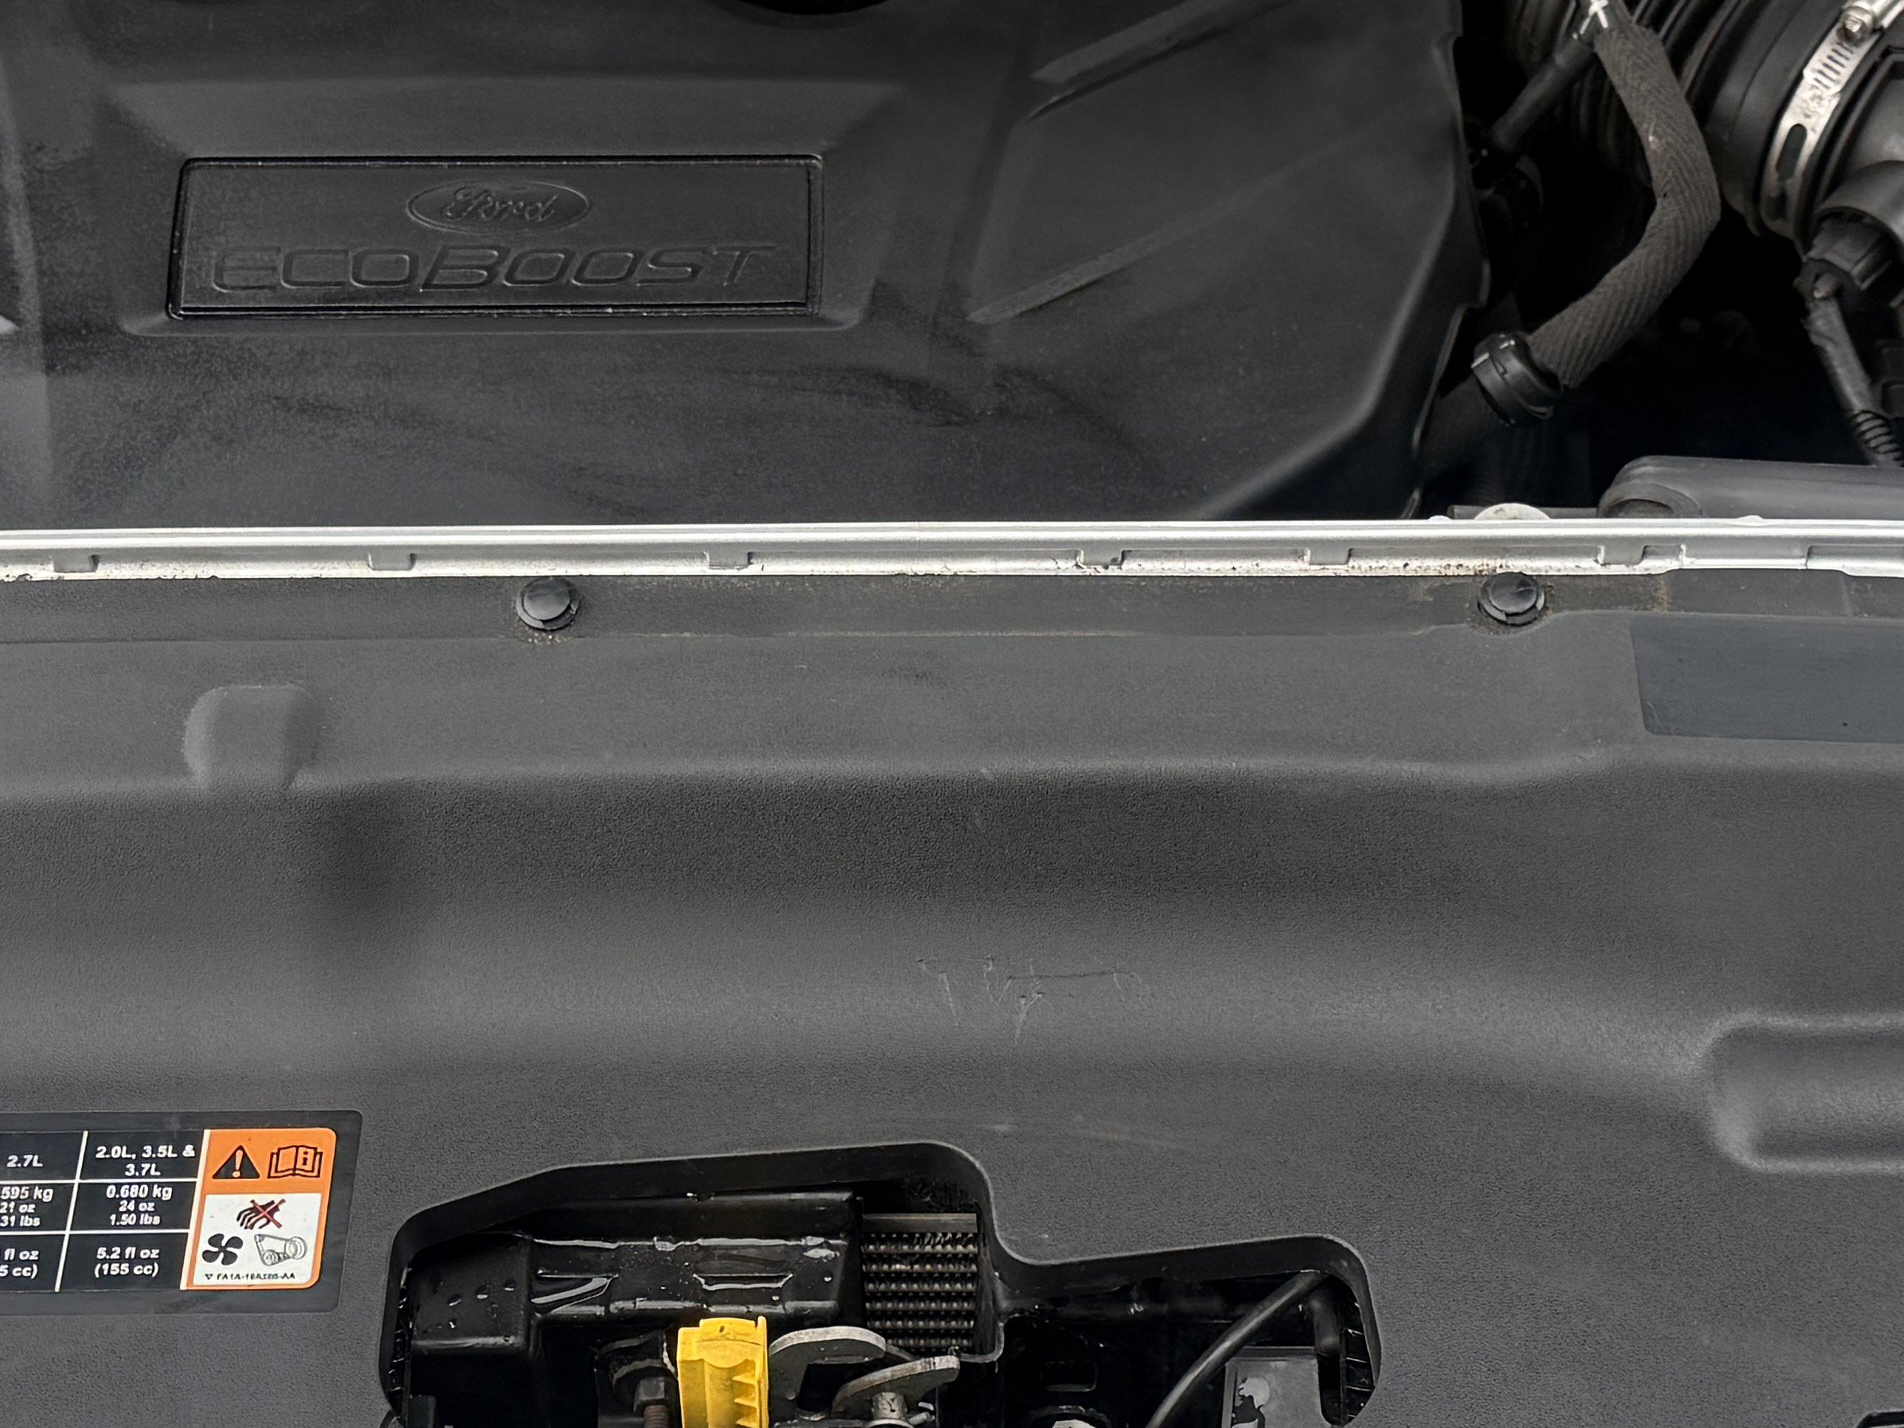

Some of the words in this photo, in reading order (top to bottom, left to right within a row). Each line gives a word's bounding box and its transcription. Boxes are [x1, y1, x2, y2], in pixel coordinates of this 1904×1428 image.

[443, 180, 556, 225] Ford
[96, 1145, 137, 1160] 2.0L,
[142, 1145, 177, 1158] 3.5L
[182, 1144, 196, 1157] &
[6, 1155, 43, 1167] 2.7L
[125, 1163, 160, 1176] 3.7L
[34, 1186, 54, 1202] kg
[106, 1185, 148, 1198] 0.680
[153, 1185, 173, 1200] kg
[0, 1202, 16, 1213] 21
[19, 1203, 36, 1213] oz
[119, 1201, 136, 1212] 24
[139, 1202, 155, 1212] oz
[19, 1215, 41, 1227] lbs
[109, 1214, 137, 1226] 1.50
[139, 1214, 161, 1225] lbs
[4, 1248, 15, 1260] fl
[19, 1249, 40, 1260] oz
[96, 1247, 121, 1259] 5.2
[125, 1246, 135, 1259] fl
[139, 1247, 159, 1258] oz
[12, 1264, 38, 1279] cc)
[94, 1263, 130, 1278] (155
[133, 1262, 159, 1277] cc)
